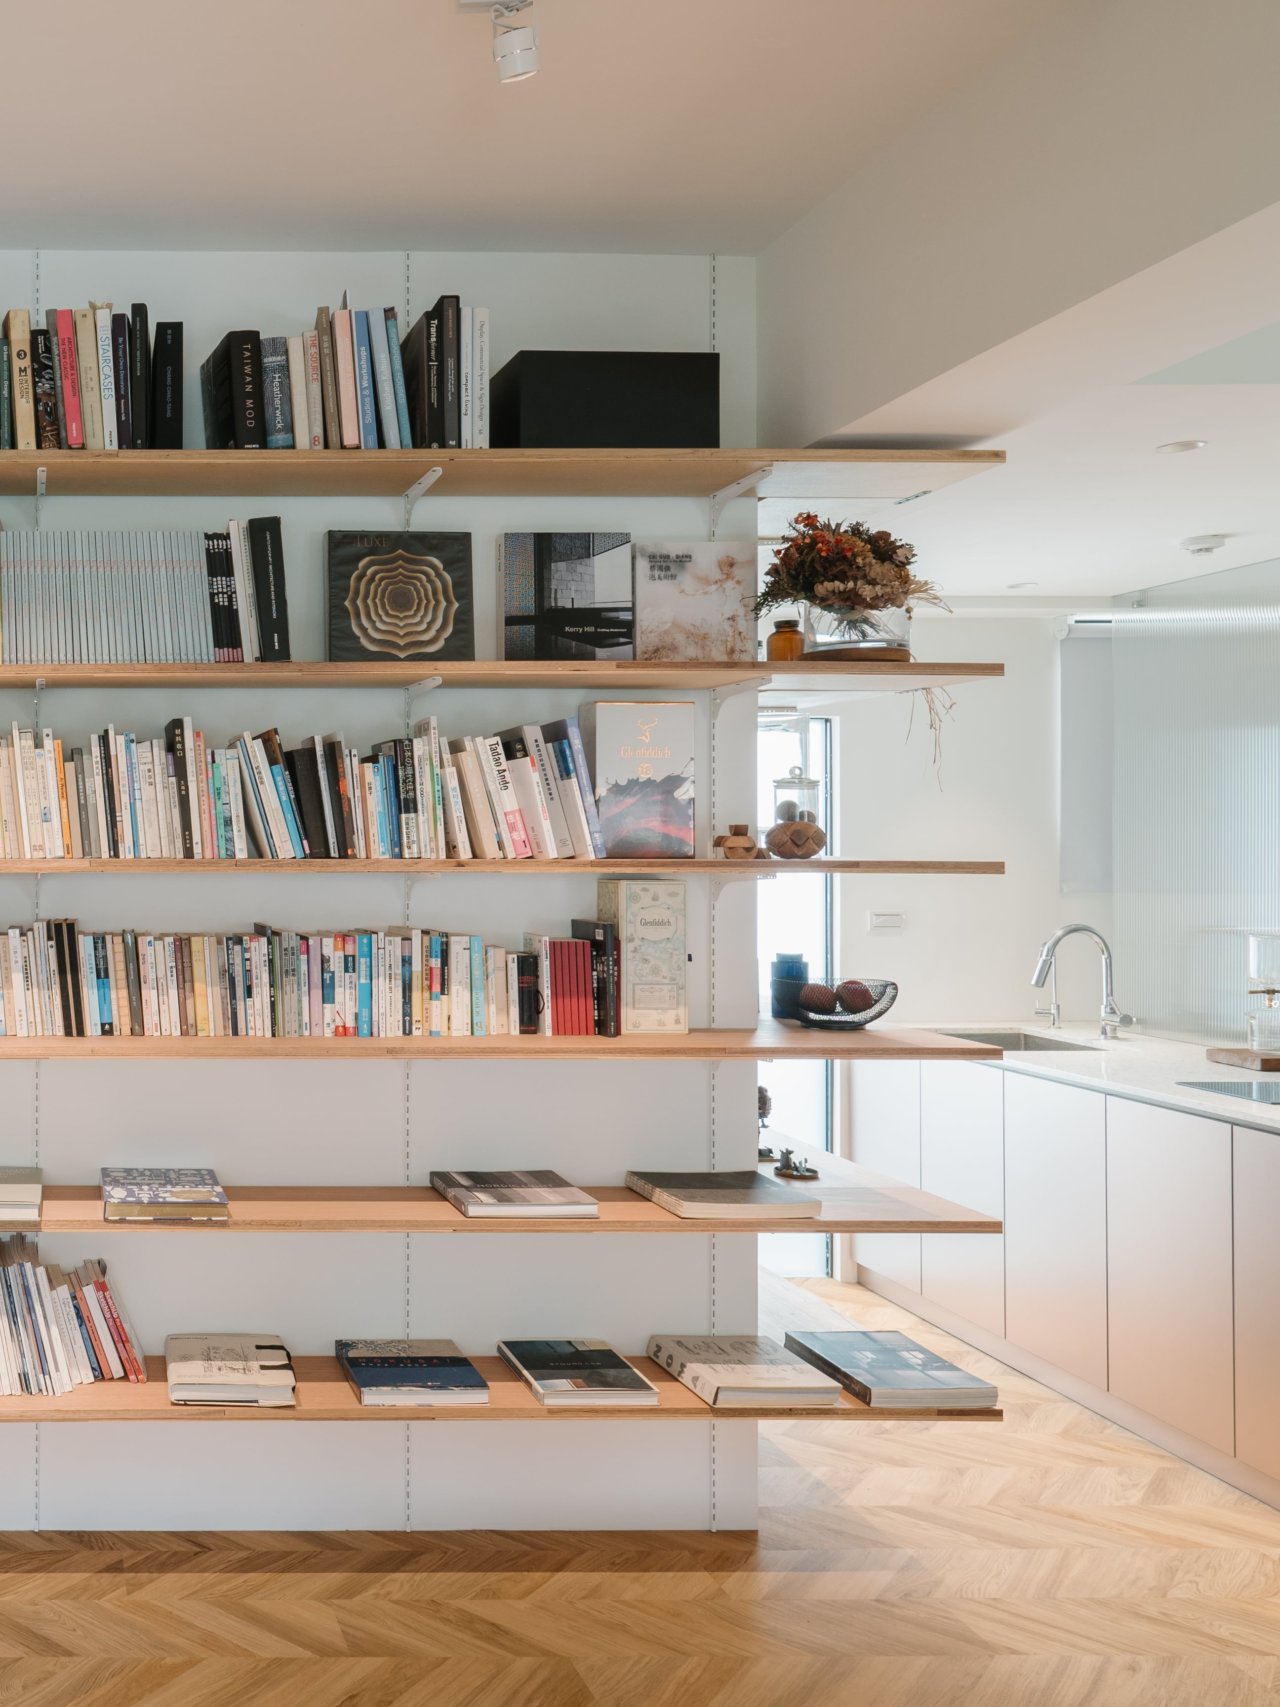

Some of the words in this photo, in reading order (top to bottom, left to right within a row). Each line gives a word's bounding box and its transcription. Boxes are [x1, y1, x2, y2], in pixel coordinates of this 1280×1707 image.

[309, 335, 318, 350] THE
[428, 319, 438, 361] Transformer
[100, 336, 113, 400] STAIRCASES
[242, 344, 253, 393] TAIWAN
[310, 352, 319, 383] SOURCE
[360, 347, 368, 388] Workshops
[245, 400, 255, 428] MOD
[273, 374, 284, 430] Heatherwick
[366, 398, 374, 423] Studios
[488, 741, 503, 767] Tadao
[496, 769, 510, 791] Ando
[640, 918, 672, 927] Glenfiddich
[97, 1291, 112, 1319] SketchUp
[104, 1291, 119, 1318] SketchUp
